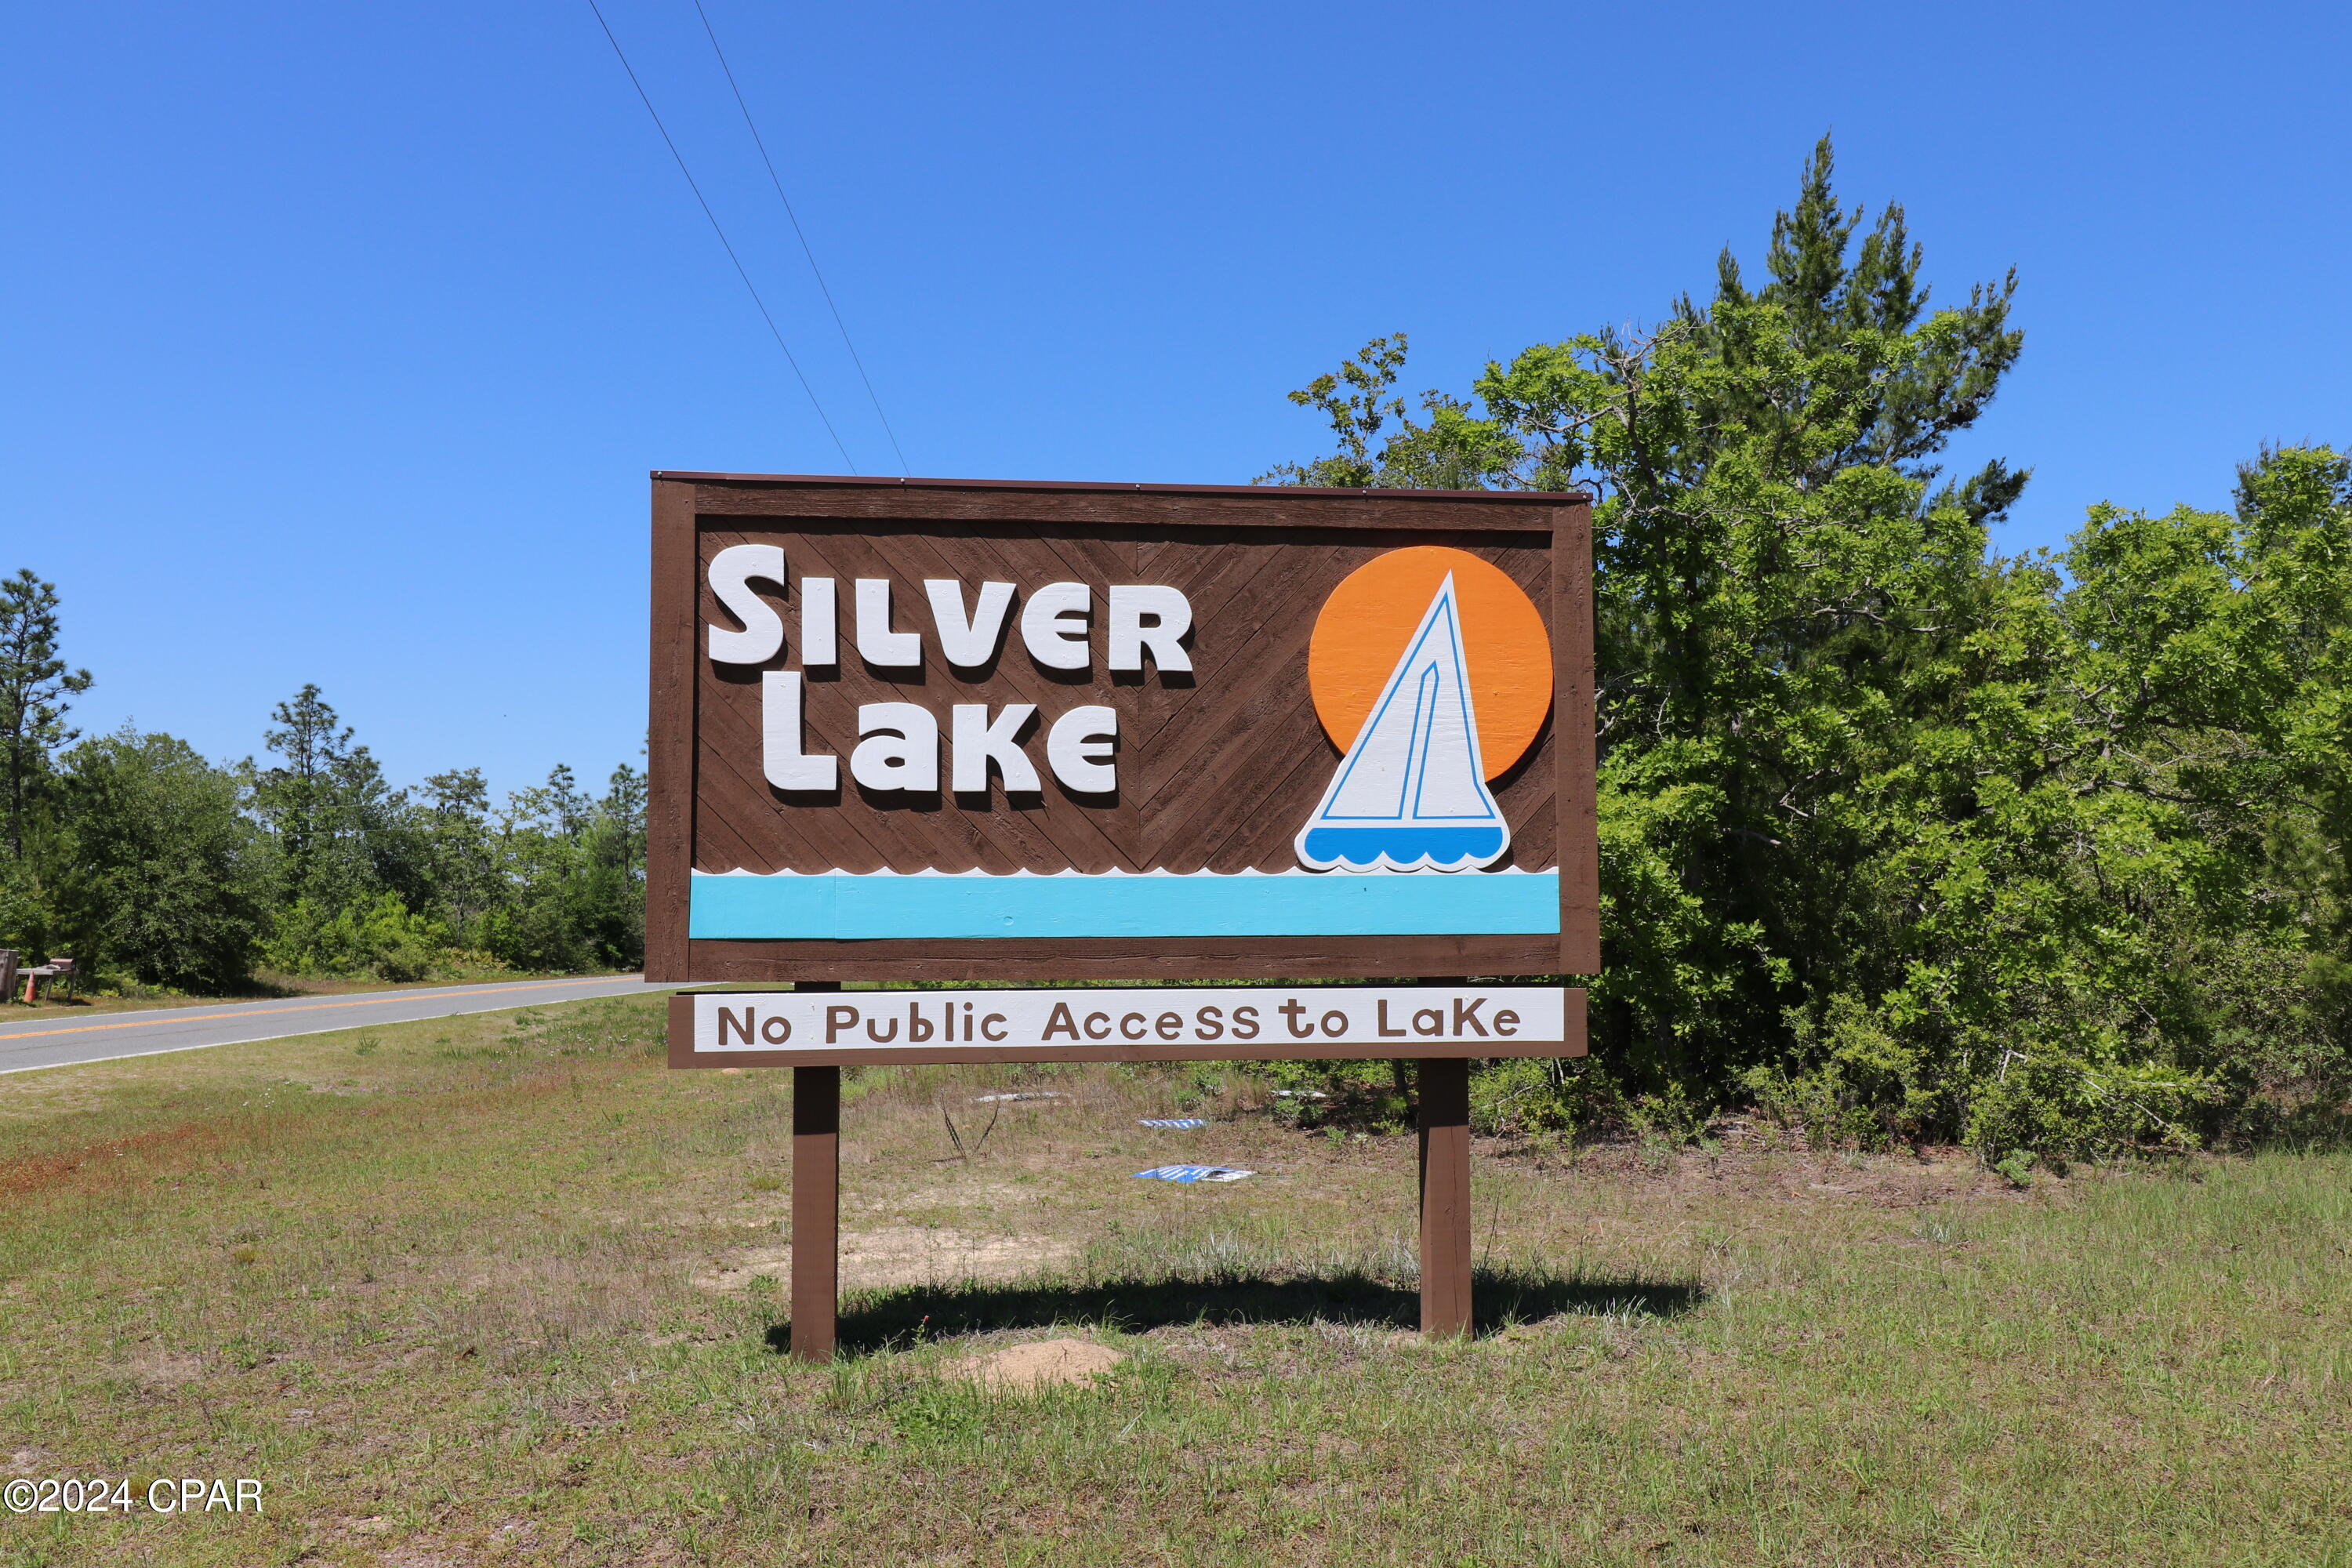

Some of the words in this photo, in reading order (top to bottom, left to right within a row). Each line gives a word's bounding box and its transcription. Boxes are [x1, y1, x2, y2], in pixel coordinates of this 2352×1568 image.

[717, 1007, 792, 1046] No
[826, 1001, 1008, 1044] Public
[1041, 1002, 1260, 1041] Access
[1278, 998, 1349, 1039] to
